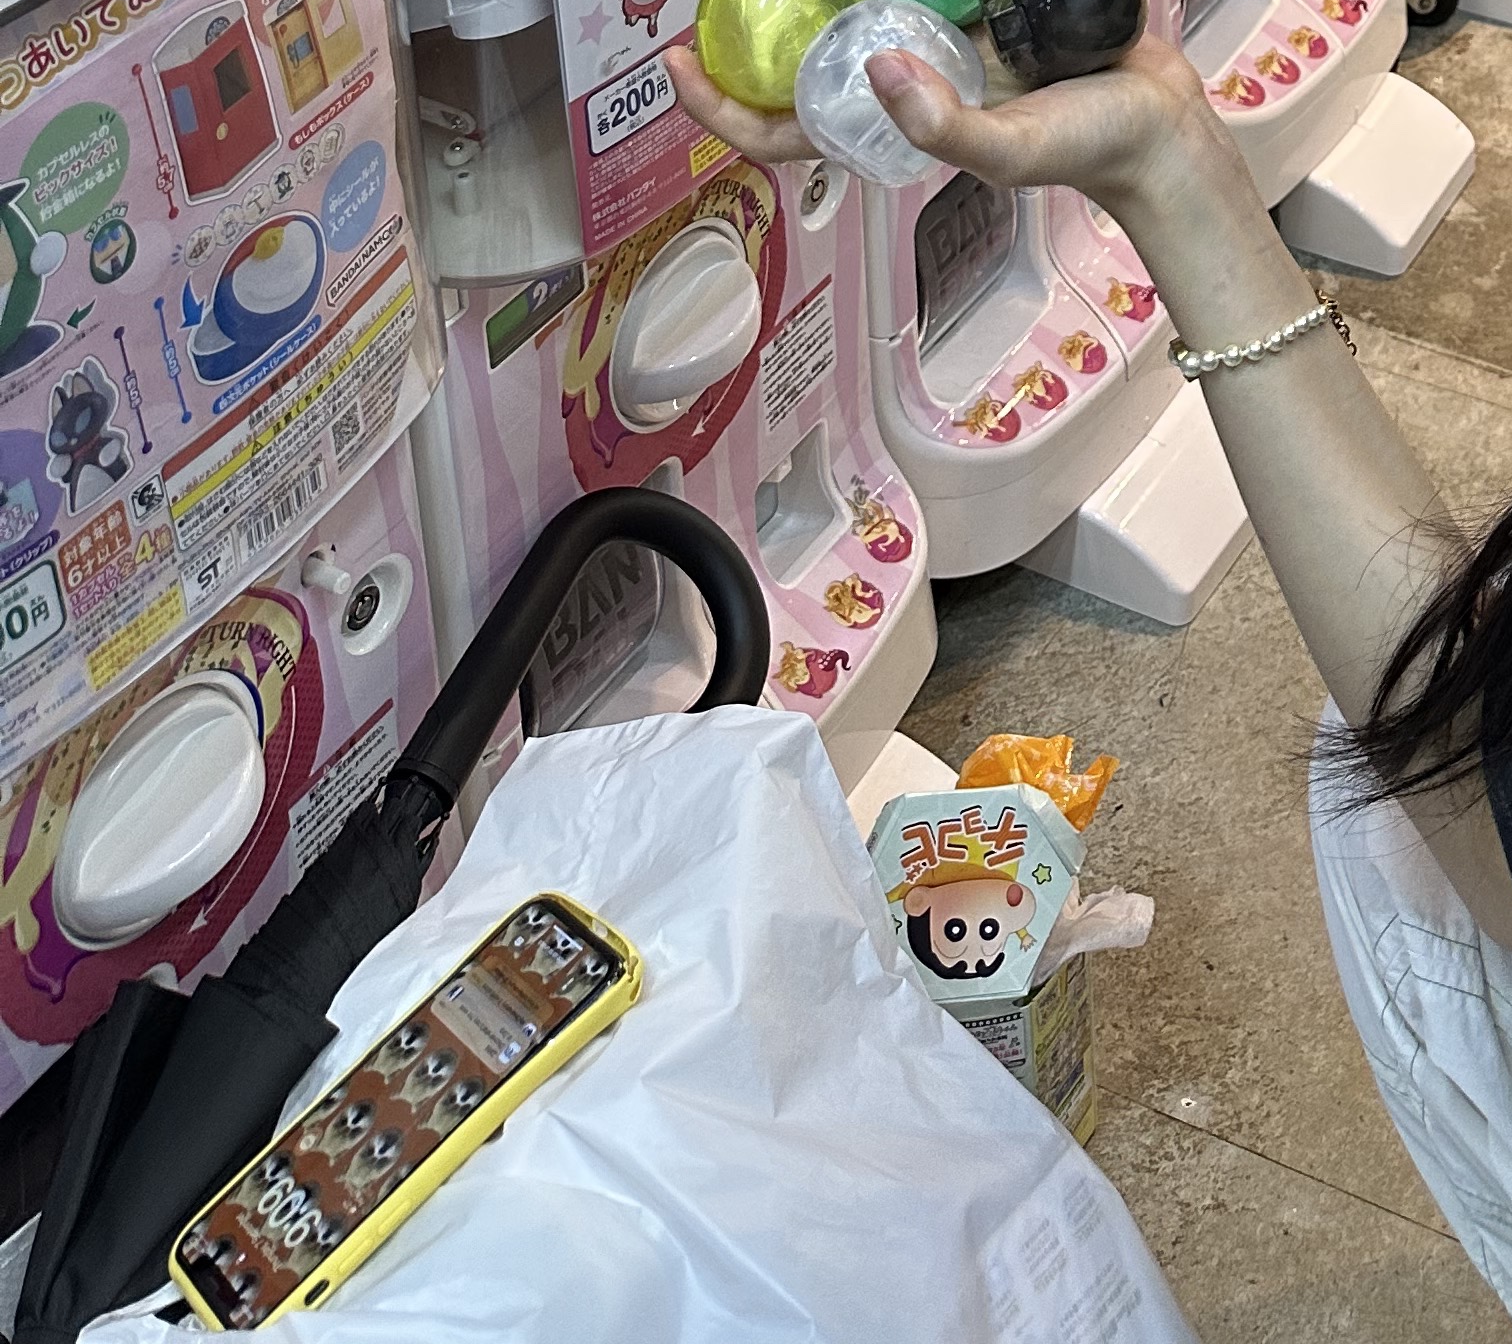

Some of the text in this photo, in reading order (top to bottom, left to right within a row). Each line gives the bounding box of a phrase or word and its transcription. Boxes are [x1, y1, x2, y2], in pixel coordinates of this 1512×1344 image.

[597, 80, 669, 136] 各200円
[37, 123, 110, 180] カプセルレスの
[592, 175, 657, 220] 株式会社バンダイ
[595, 223, 617, 241] MADE
[330, 260, 363, 300] BANDAI
[65, 505, 127, 564] 対象年齢
[67, 536, 127, 587] 6才以上
[120, 526, 174, 583] 全4種
[197, 559, 221, 590] ST
[207, 620, 298, 683] TURN RIGHT
[899, 805, 1029, 883] チョコビ
[258, 1176, 322, 1249] 9:09
